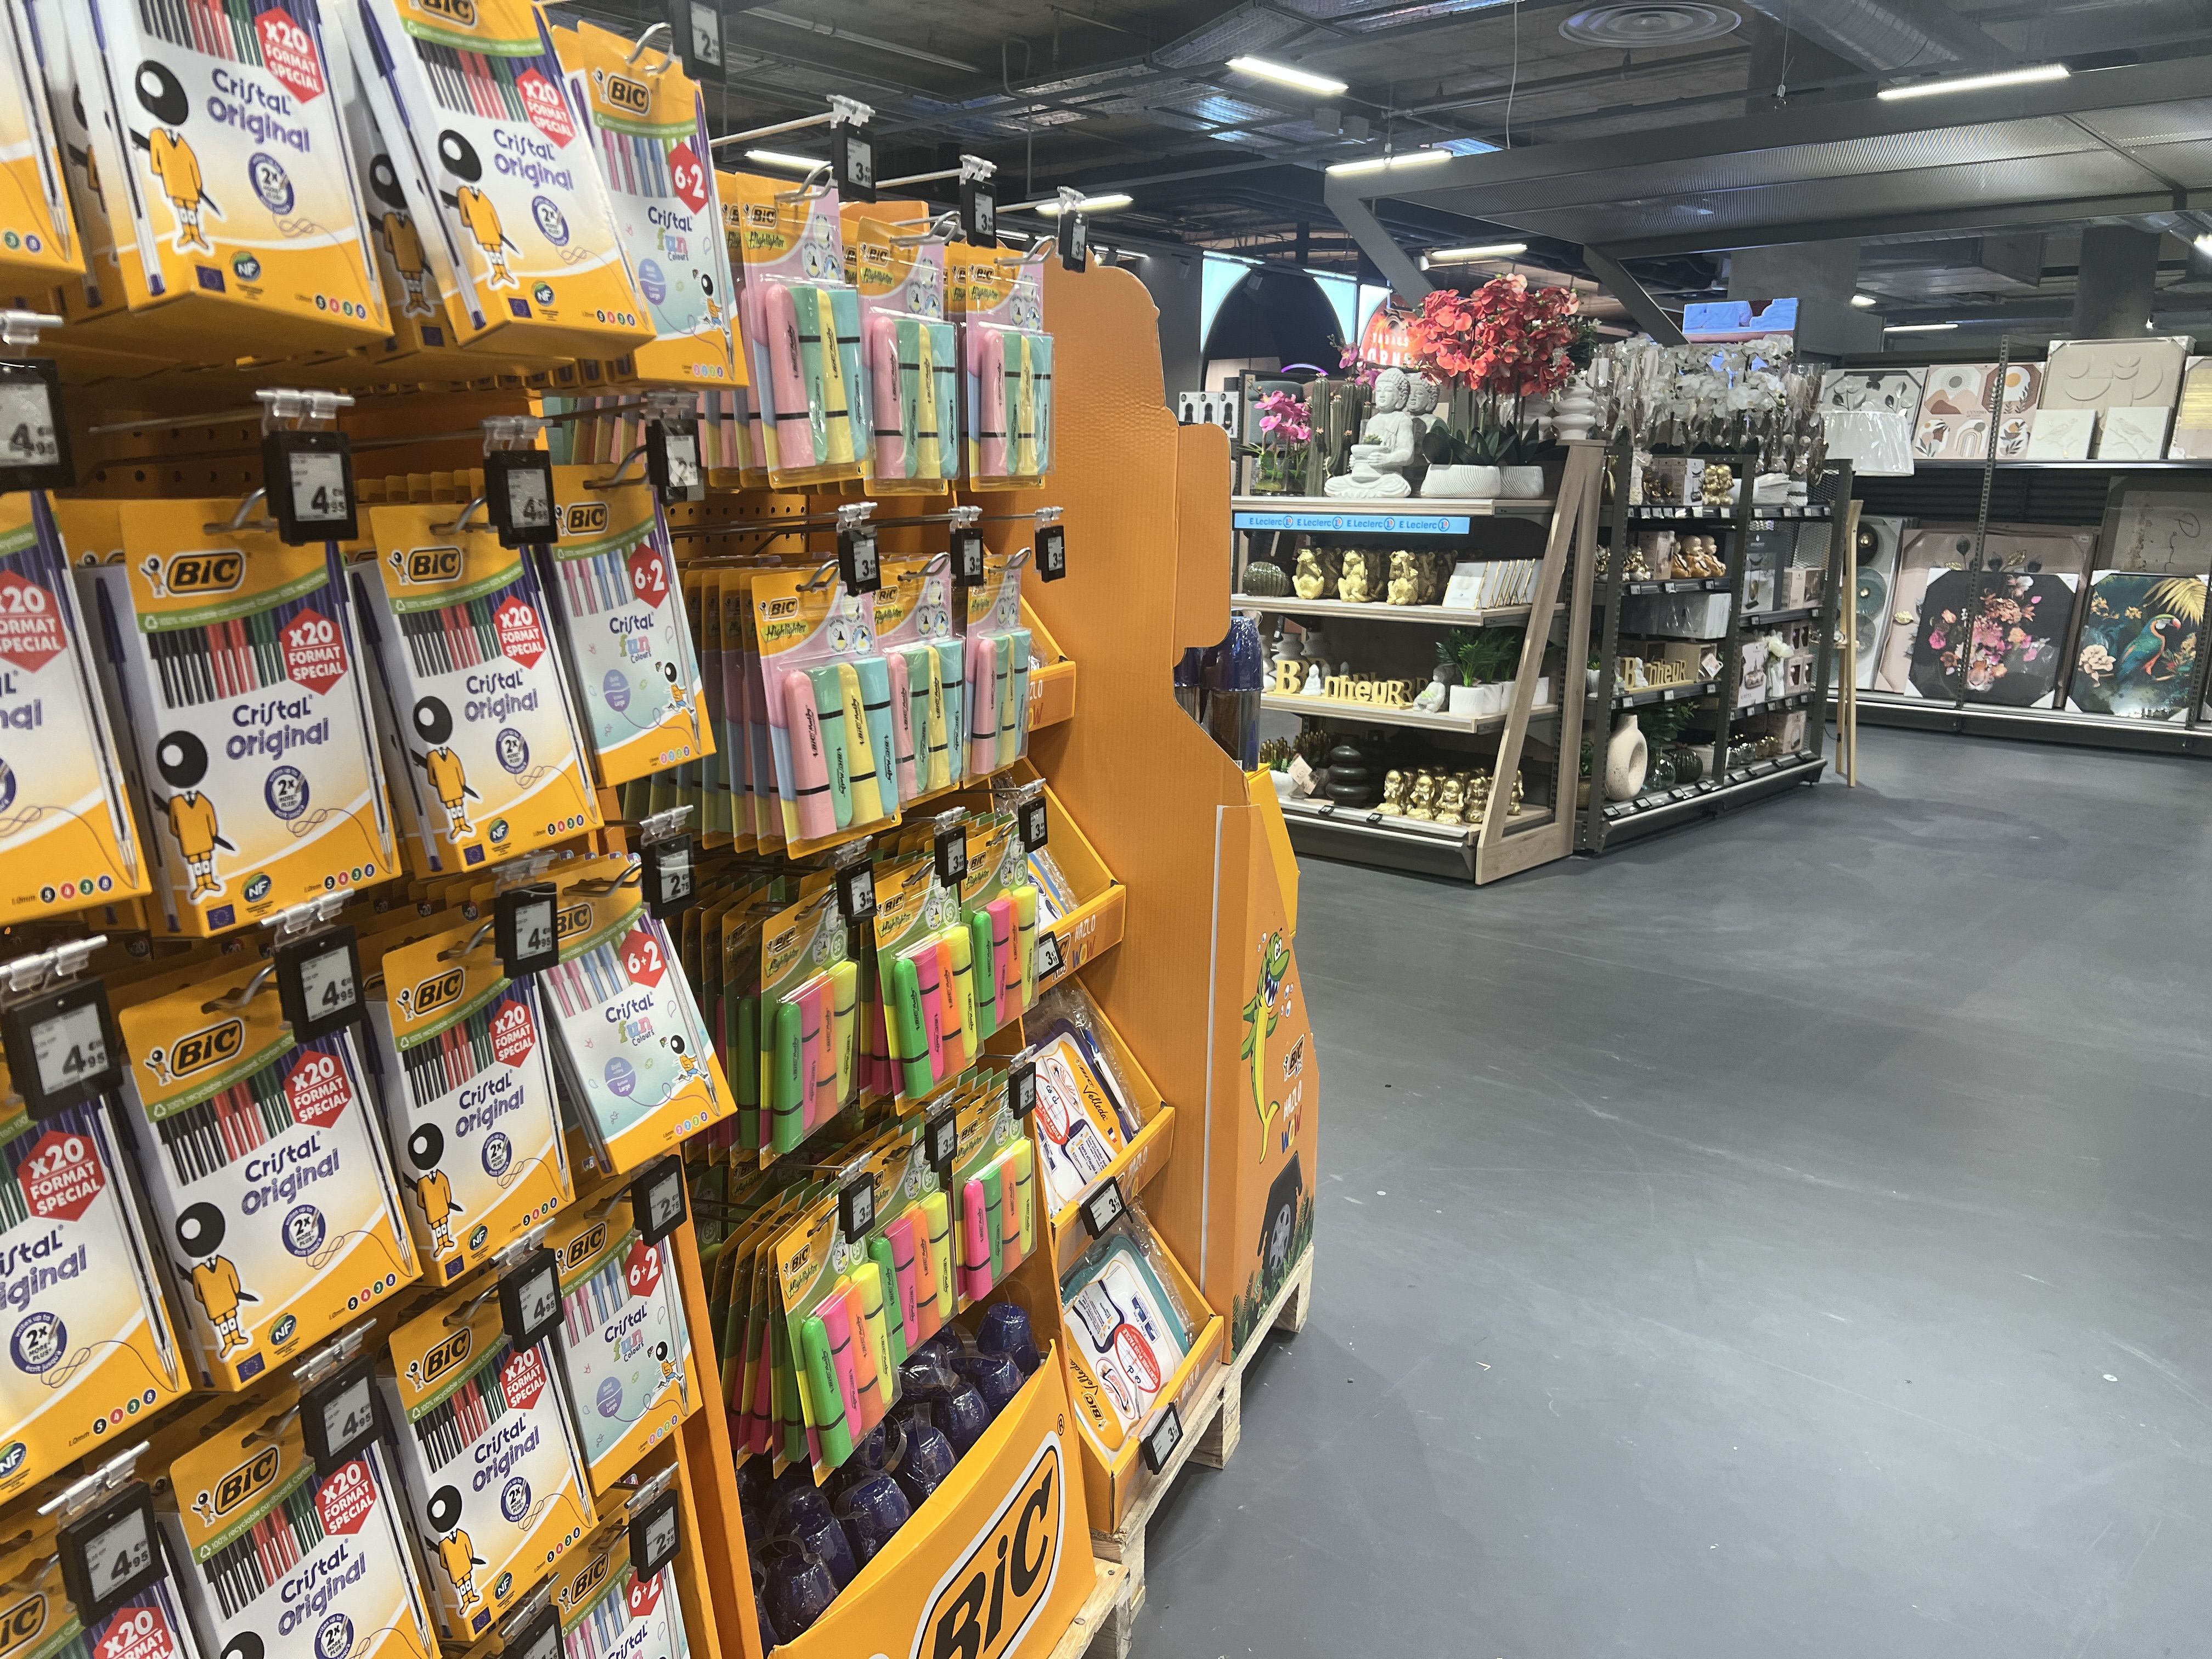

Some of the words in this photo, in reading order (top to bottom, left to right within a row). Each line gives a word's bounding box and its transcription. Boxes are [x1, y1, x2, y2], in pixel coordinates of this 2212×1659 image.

[264, 20, 308, 54] x20
[702, 33, 712, 56] 2
[264, 43, 318, 75] FORMAT
[269, 61, 321, 93] SPECIAL
[523, 80, 560, 107] x20
[611, 83, 647, 109] BIC
[527, 100, 569, 123] FORMAT
[207, 97, 310, 153] Original
[534, 115, 574, 138] SPECIAL
[493, 153, 574, 191] Original
[674, 163, 705, 199] 6+2
[856, 162, 865, 179] 3
[754, 209, 776, 223] BIC
[981, 212, 988, 230] 3
[657, 227, 689, 253] fun
[235, 260, 259, 276] NF
[869, 249, 889, 262] BIC
[977, 268, 994, 281] BIC
[535, 290, 553, 303] NF
[10, 423, 33, 458] 4
[311, 486, 328, 515] 4
[570, 507, 605, 529] BIC
[174, 557, 236, 587] BIC
[413, 552, 458, 577] BIC
[862, 560, 870, 577] 3
[969, 556, 976, 572] 3
[1053, 552, 1059, 570] 3
[634, 560, 666, 591] 6+2
[878, 589, 896, 601] BIC
[500, 607, 533, 629] x20
[771, 601, 796, 616] BIC
[289, 621, 333, 648] x20
[502, 627, 540, 645] FORMAT
[618, 633, 651, 658] fun
[287, 646, 341, 668] FORMAT
[505, 641, 544, 657] SPECIAL
[292, 662, 345, 682] SPECIAL
[1029, 679, 1043, 701] ZLO
[464, 689, 539, 723] Original
[225, 718, 330, 761] Original
[492, 826, 507, 838] NF
[1035, 822, 1041, 838] 3
[953, 855, 959, 871] 3
[970, 854, 986, 868] BIC
[249, 881, 269, 899] NF
[669, 877, 682, 898] 2
[860, 891, 867, 907] 3
[885, 898, 904, 912] BIC
[528, 927, 541, 950] 4
[540, 936, 552, 947] 95
[1075, 914, 1096, 943] HAZLO
[628, 944, 663, 975] 6+2
[1045, 950, 1053, 967] 3
[1072, 935, 1097, 969] WOW
[321, 981, 339, 1008] 4
[339, 988, 354, 1001] 95
[419, 973, 461, 1009] BIC
[495, 1006, 525, 1034] x20
[618, 1016, 653, 1044] fun
[178, 1025, 238, 1070] BIC
[495, 1024, 531, 1049] FORMAT
[631, 1029, 655, 1047] Colours
[62, 1043, 87, 1075] 4
[87, 1052, 106, 1067] 95
[498, 1037, 534, 1063] SPECIAL
[1289, 1037, 1304, 1069] BIC
[293, 1057, 336, 1092] x20
[293, 1078, 345, 1111] FORMAT
[298, 1093, 348, 1122] SPECIAL
[1083, 1084, 1109, 1122] Velleda
[1283, 1079, 1302, 1122] HAZLO
[455, 1085, 524, 1138] Original
[961, 1122, 978, 1141] BIC
[1281, 1104, 1302, 1154] WOW
[29, 1138, 84, 1179] x20
[943, 1139, 949, 1154] 3
[30, 1160, 97, 1200] FORMAT
[240, 1148, 340, 1217] Original
[36, 1181, 101, 1216] SPECIAL
[660, 1197, 672, 1217] 2
[670, 1199, 680, 1212] 75
[1109, 1197, 1116, 1213] 3
[859, 1206, 866, 1224] 3
[472, 1229, 486, 1247] NF
[570, 1226, 604, 1263] BIC
[629, 1247, 658, 1287] 6+2
[791, 1246, 810, 1271] BIC
[533, 1299, 546, 1319] 4
[545, 1301, 556, 1312] 95
[26, 1325, 48, 1350] 2x
[275, 1319, 293, 1341] NF
[427, 1332, 467, 1378] BIC
[612, 1327, 644, 1362] fun
[623, 1340, 645, 1364] Colours
[505, 1349, 534, 1383] x20
[1069, 1358, 1099, 1395] Velleda
[506, 1364, 541, 1398] FORMAT
[510, 1378, 545, 1408] SPECIAL
[1084, 1395, 1103, 1420] BIC
[342, 1410, 359, 1435] 4
[358, 1411, 373, 1426] 95
[1167, 1430, 1175, 1443] 3
[0, 1447, 22, 1474] NF
[472, 1425, 540, 1493] Original
[221, 1452, 275, 1509] BIC
[323, 1463, 361, 1505] x20
[324, 1480, 370, 1522] FORMAT
[509, 1486, 521, 1506] 2x
[211, 1534, 229, 1550] 100%
[227, 1510, 261, 1537] recyclable
[259, 1482, 294, 1513] cardboard.
[329, 1496, 375, 1534] SPECIAL
[656, 1534, 666, 1554] 2
[665, 1534, 675, 1546] 75
[111, 1549, 132, 1581] 4
[132, 1550, 149, 1568] 95
[933, 1464, 1055, 1659] BIC
[497, 1576, 510, 1596] NF
[574, 1556, 606, 1600] BIC
[278, 1551, 366, 1637] Original
[104, 1610, 154, 1658] x20
[317, 1619, 330, 1639] writes
[325, 1624, 341, 1648] 2x
